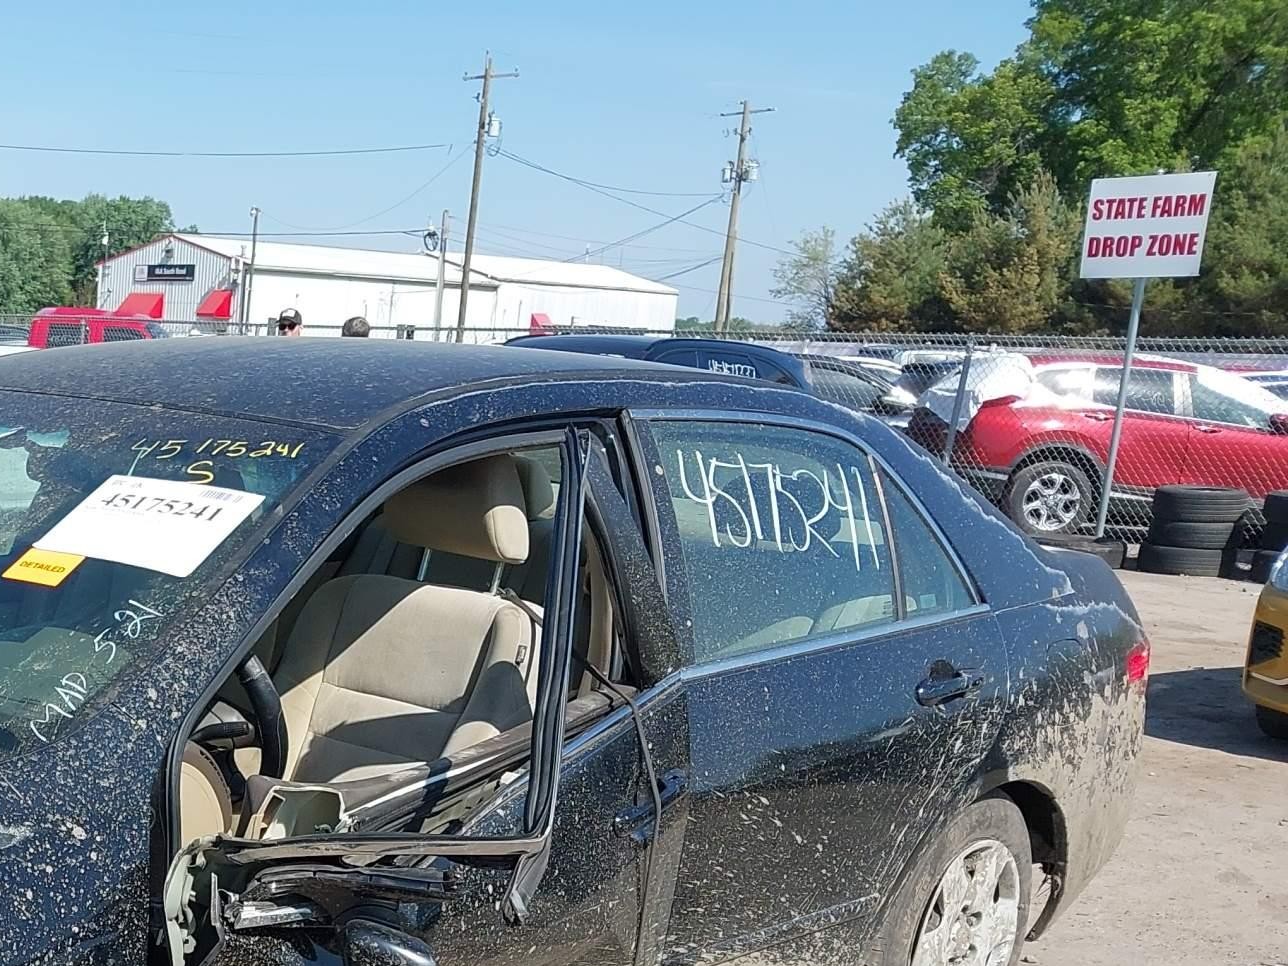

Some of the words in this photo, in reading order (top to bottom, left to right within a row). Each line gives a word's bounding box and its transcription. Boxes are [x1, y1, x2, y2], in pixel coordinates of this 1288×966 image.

[1092, 197, 1148, 221] STATE
[1150, 193, 1207, 218] FARM
[1087, 235, 1143, 258] DROP
[1145, 233, 1200, 256] ZONE
[186, 460, 215, 485] S
[101, 493, 223, 522] 45175241
[676, 449, 881, 571] 45175241
[19, 561, 66, 573] DETAILED
[93, 627, 116, 664] 5
[114, 599, 164, 638] 21
